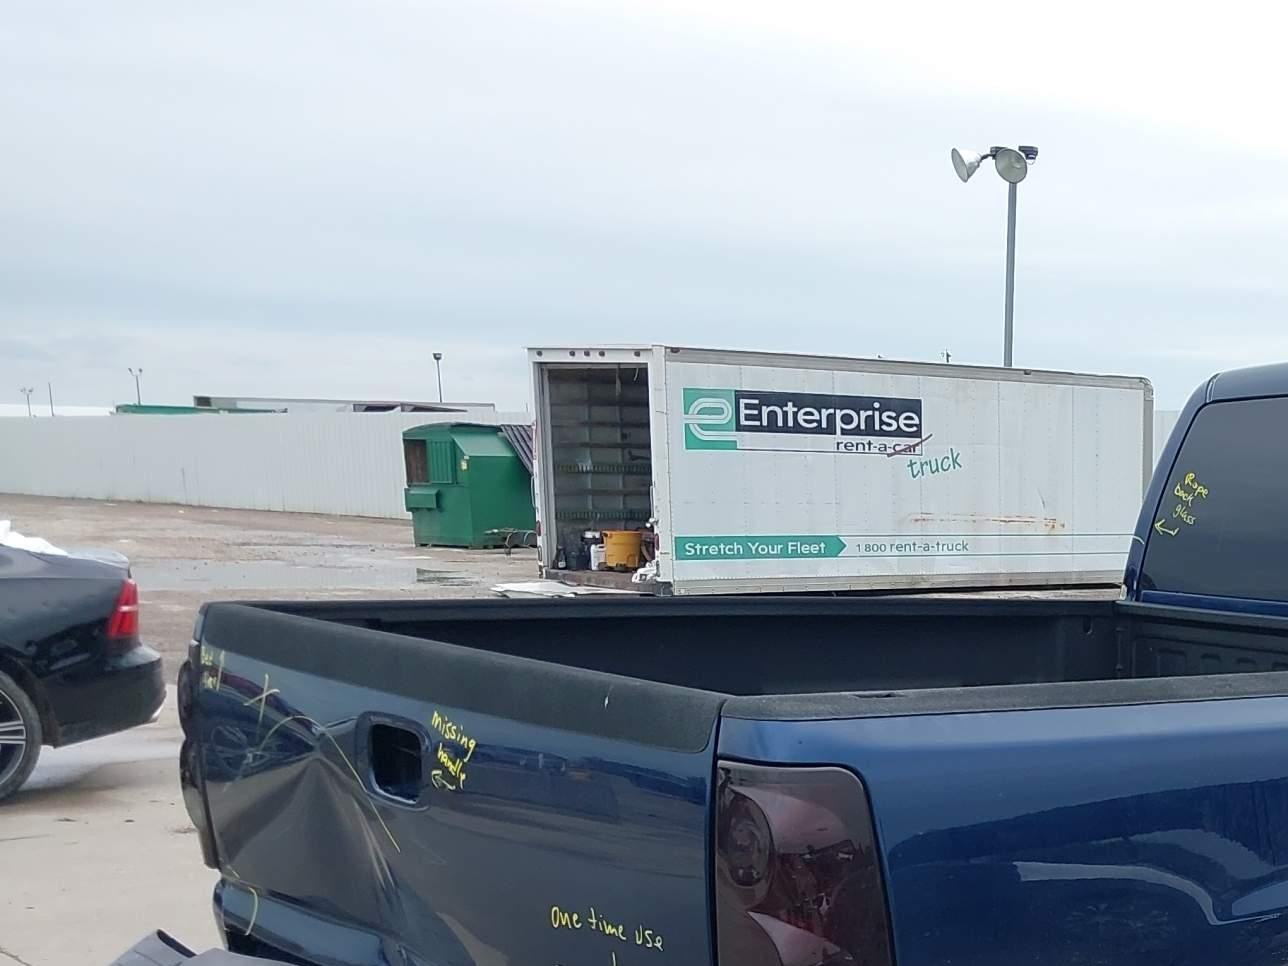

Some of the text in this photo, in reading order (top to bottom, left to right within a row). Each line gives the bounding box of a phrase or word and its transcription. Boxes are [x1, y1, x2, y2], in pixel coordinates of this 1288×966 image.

[739, 398, 920, 436] Enterprise
[836, 439, 920, 454] rent-a-car
[907, 448, 963, 479] truck
[1172, 504, 1197, 525] glass
[684, 541, 826, 556] Stretch Your Fleet
[864, 543, 887, 553] 800
[889, 540, 969, 553] rent-a-truck
[551, 906, 582, 928] One
[588, 907, 627, 941] time
